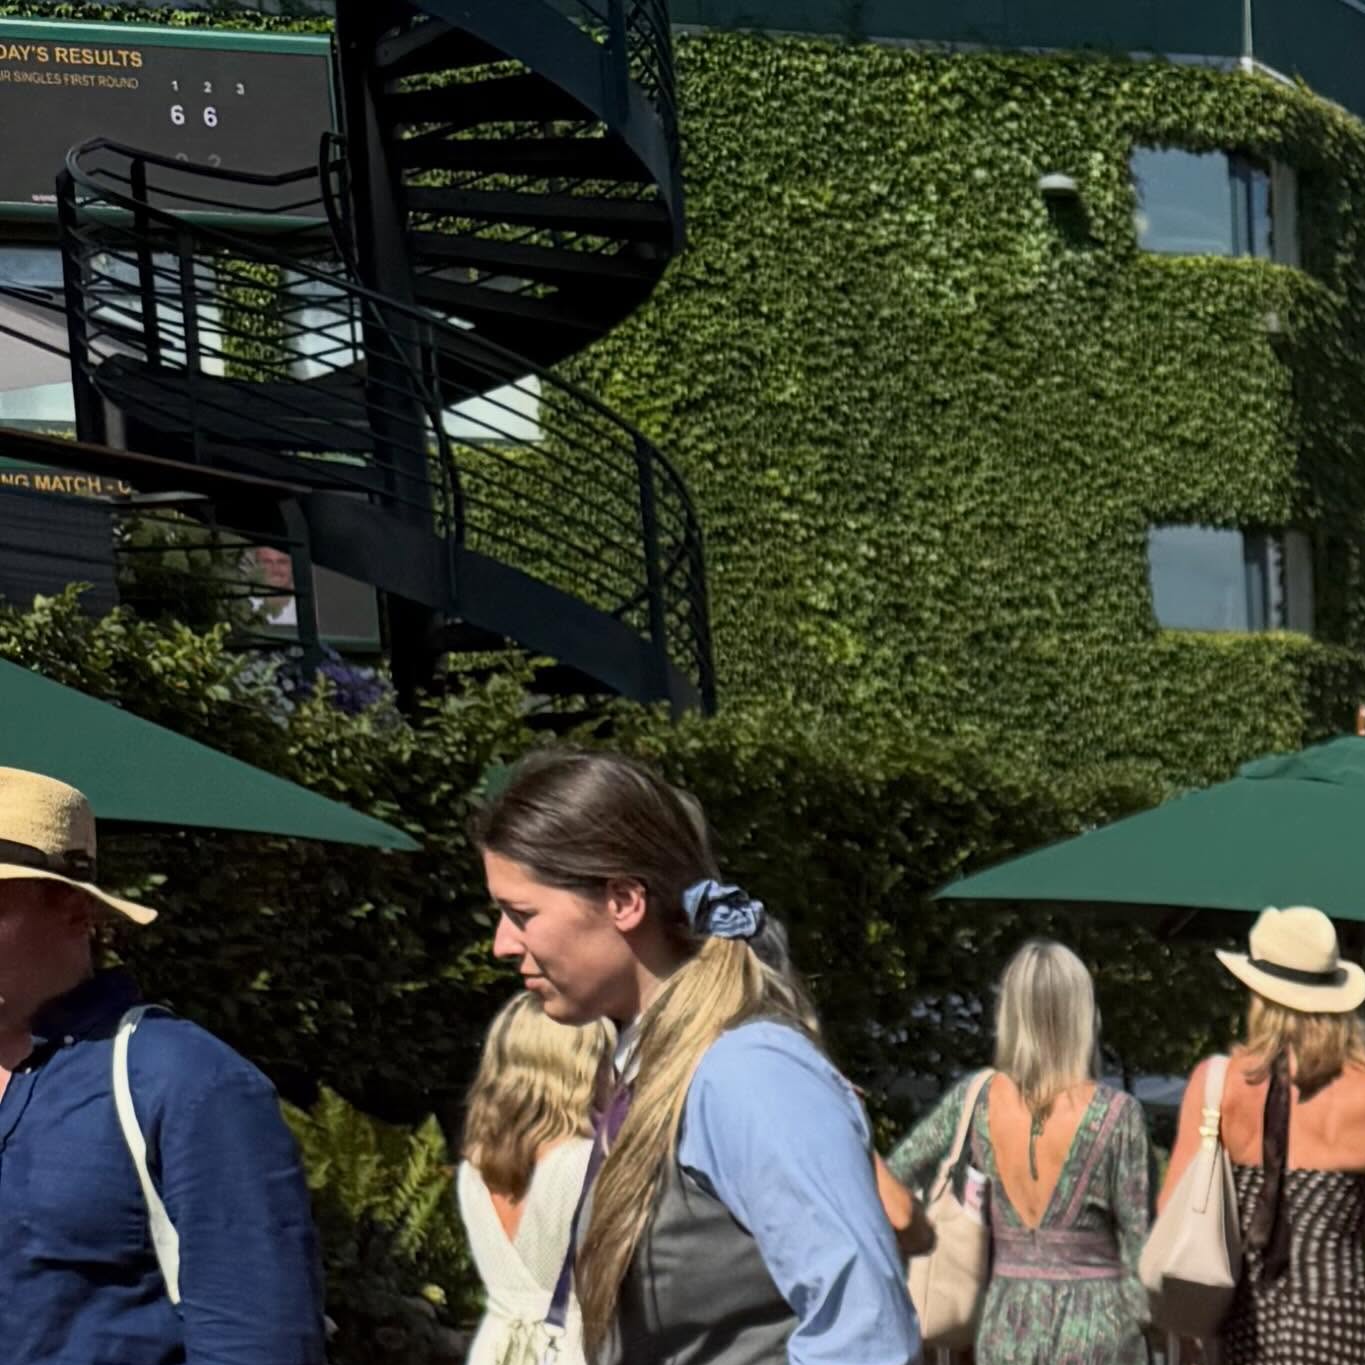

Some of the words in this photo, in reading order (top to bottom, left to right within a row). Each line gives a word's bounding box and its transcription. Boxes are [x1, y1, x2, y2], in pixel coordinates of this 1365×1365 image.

[55, 47, 143, 67] RESULTS
[14, 71, 61, 85] SINGLES
[64, 73, 95, 87] FIRST
[98, 75, 139, 89] ROUND
[171, 80, 178, 91] 1
[204, 81, 212, 93] 2
[236, 83, 245, 95] 3
[171, 104, 185, 125] 6
[203, 106, 218, 127] 6
[34, 474, 101, 492] MATCH
